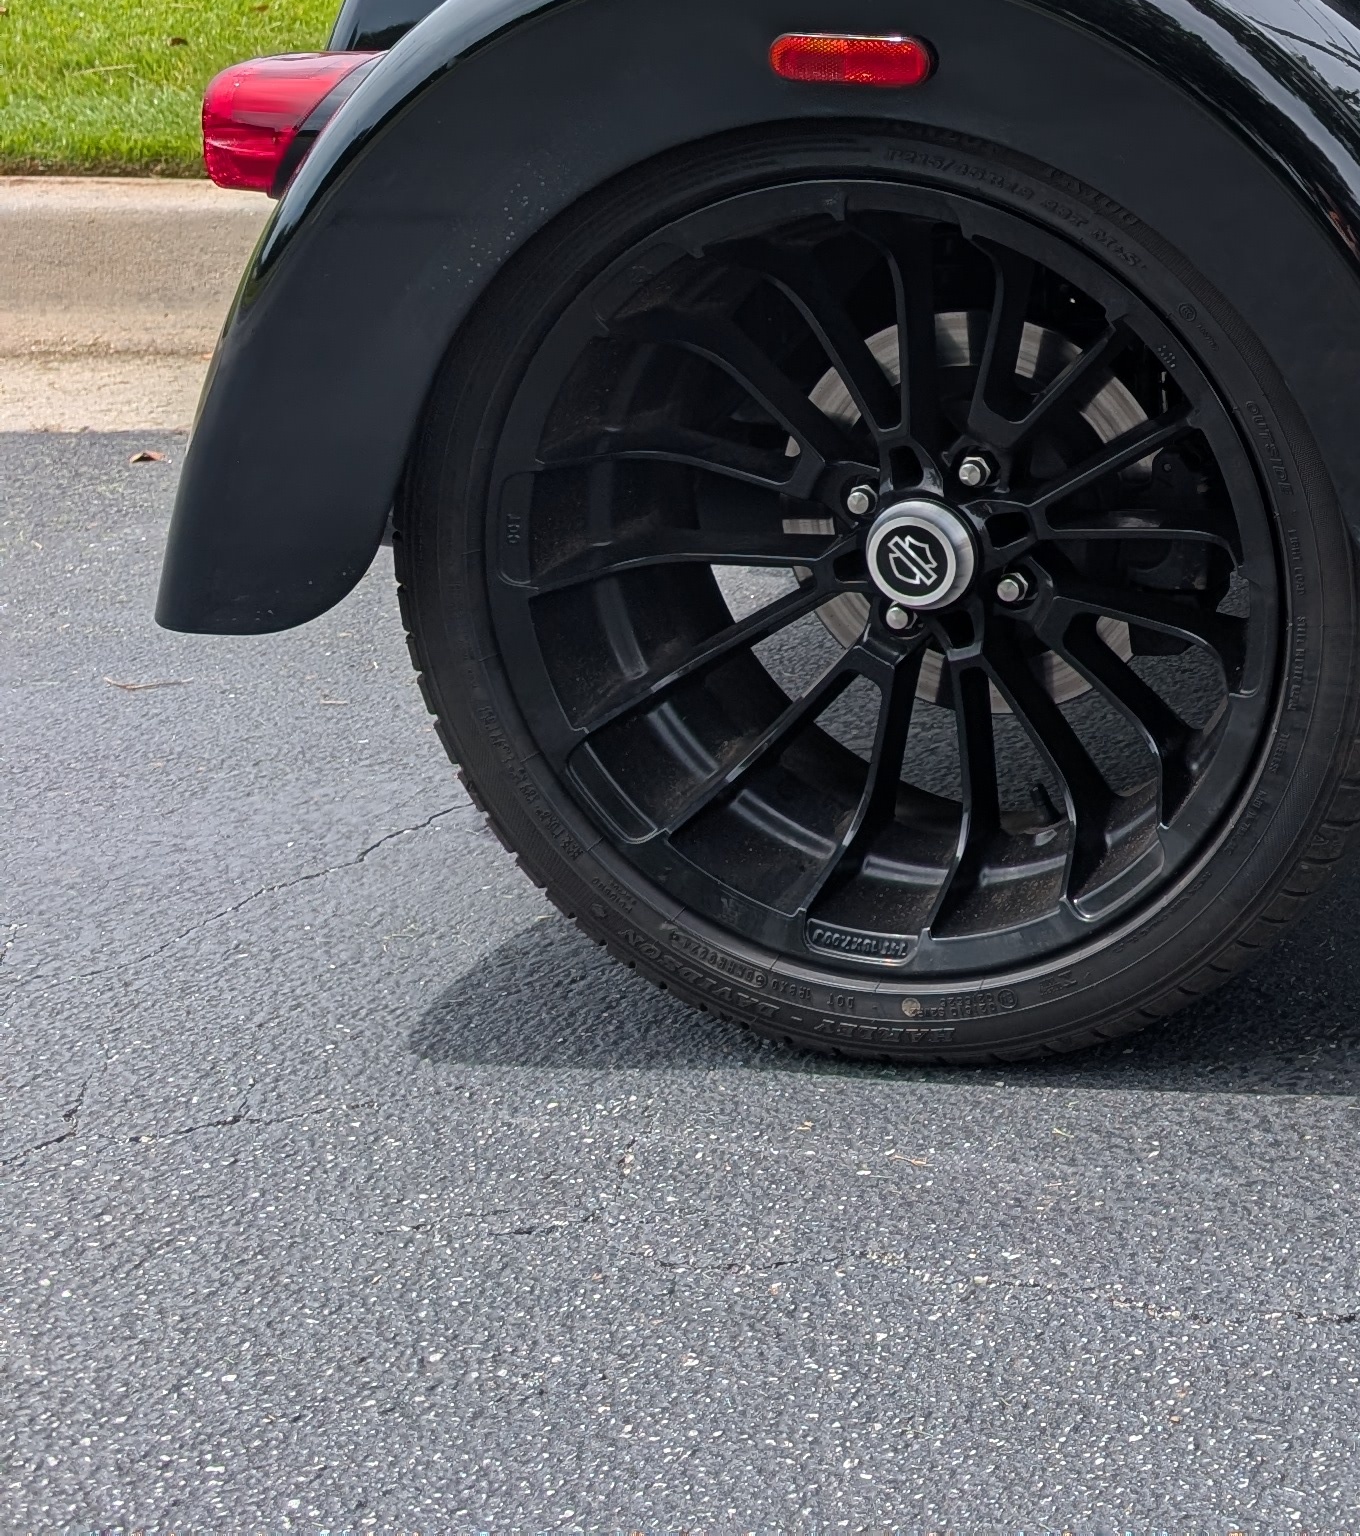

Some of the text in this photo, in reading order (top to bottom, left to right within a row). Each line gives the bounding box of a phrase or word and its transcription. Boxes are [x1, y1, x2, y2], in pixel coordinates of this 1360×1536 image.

[1245, 400, 1294, 496] OUTSIDE
[617, 929, 780, 1018] DAVIDSON
[814, 1018, 956, 1044] HARLEY
